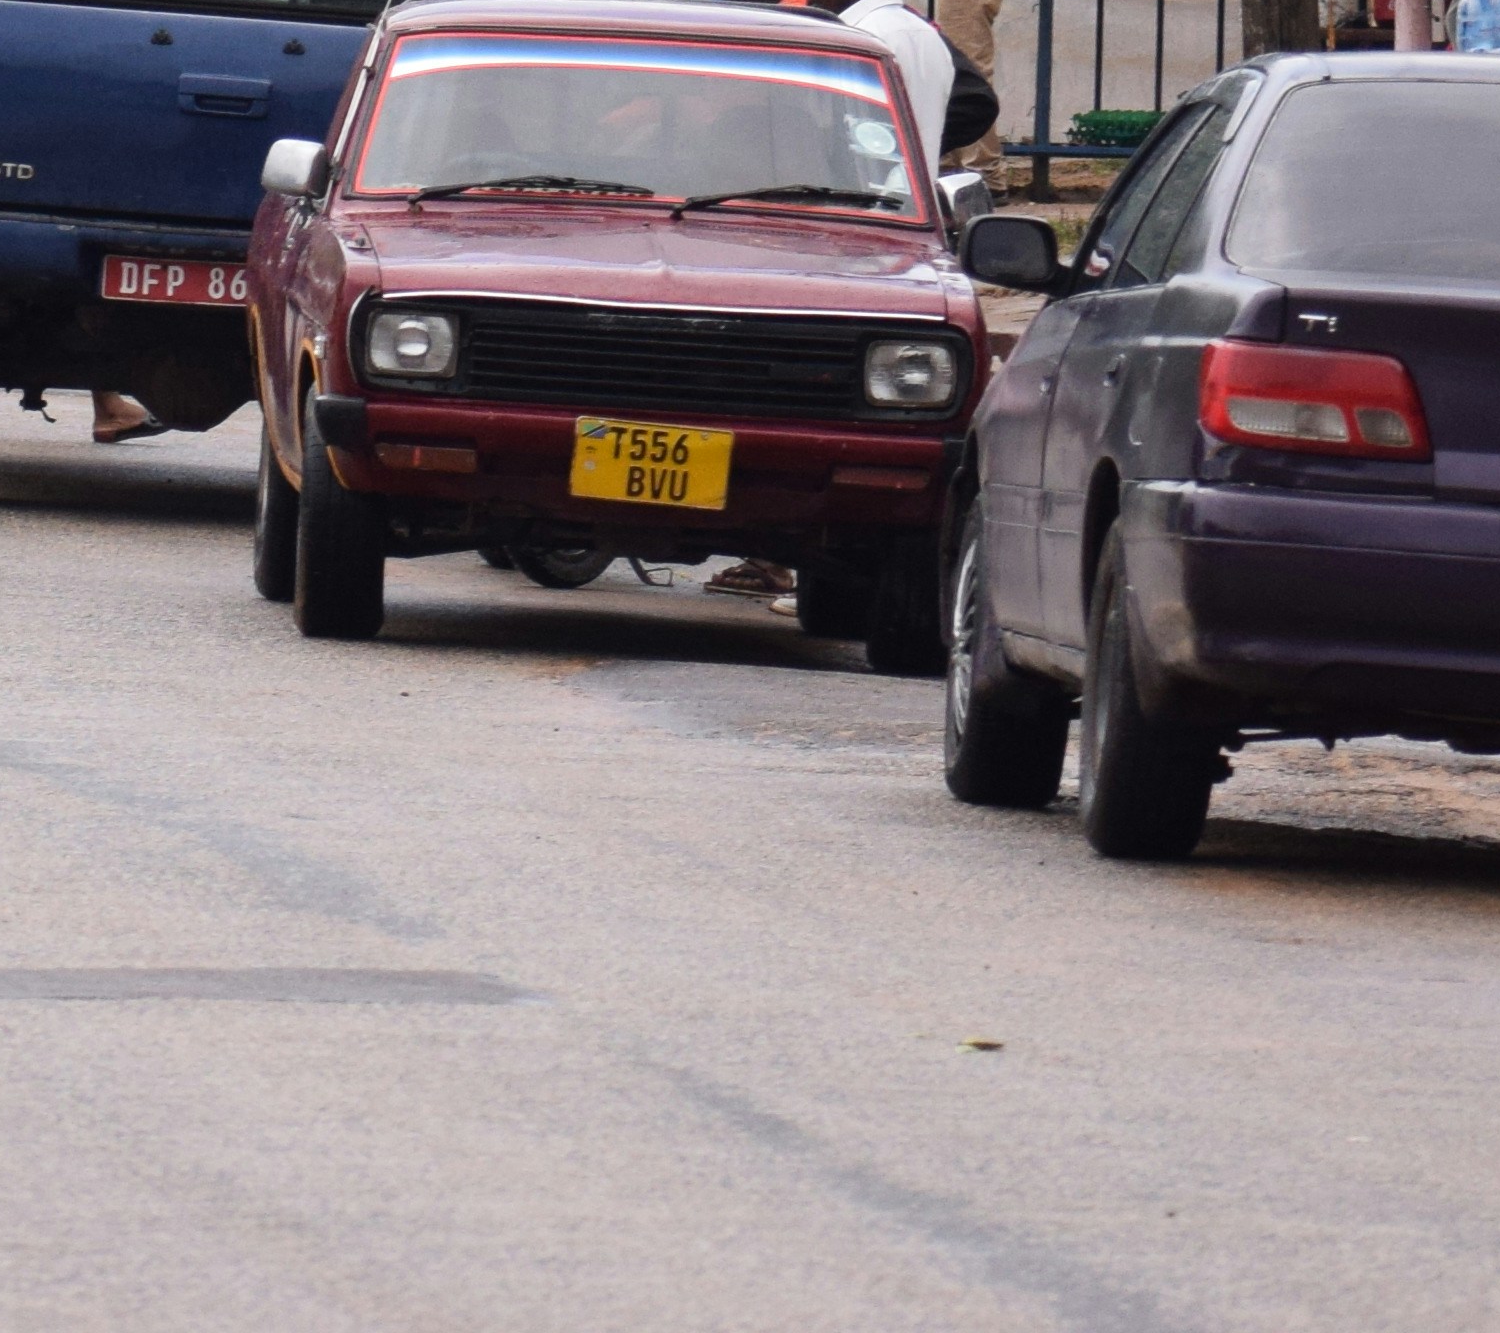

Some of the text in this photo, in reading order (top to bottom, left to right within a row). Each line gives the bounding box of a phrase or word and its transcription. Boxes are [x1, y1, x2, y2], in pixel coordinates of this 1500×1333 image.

[119, 261, 185, 297] DFP
[609, 426, 689, 465] T556
[626, 465, 689, 501] BVU
